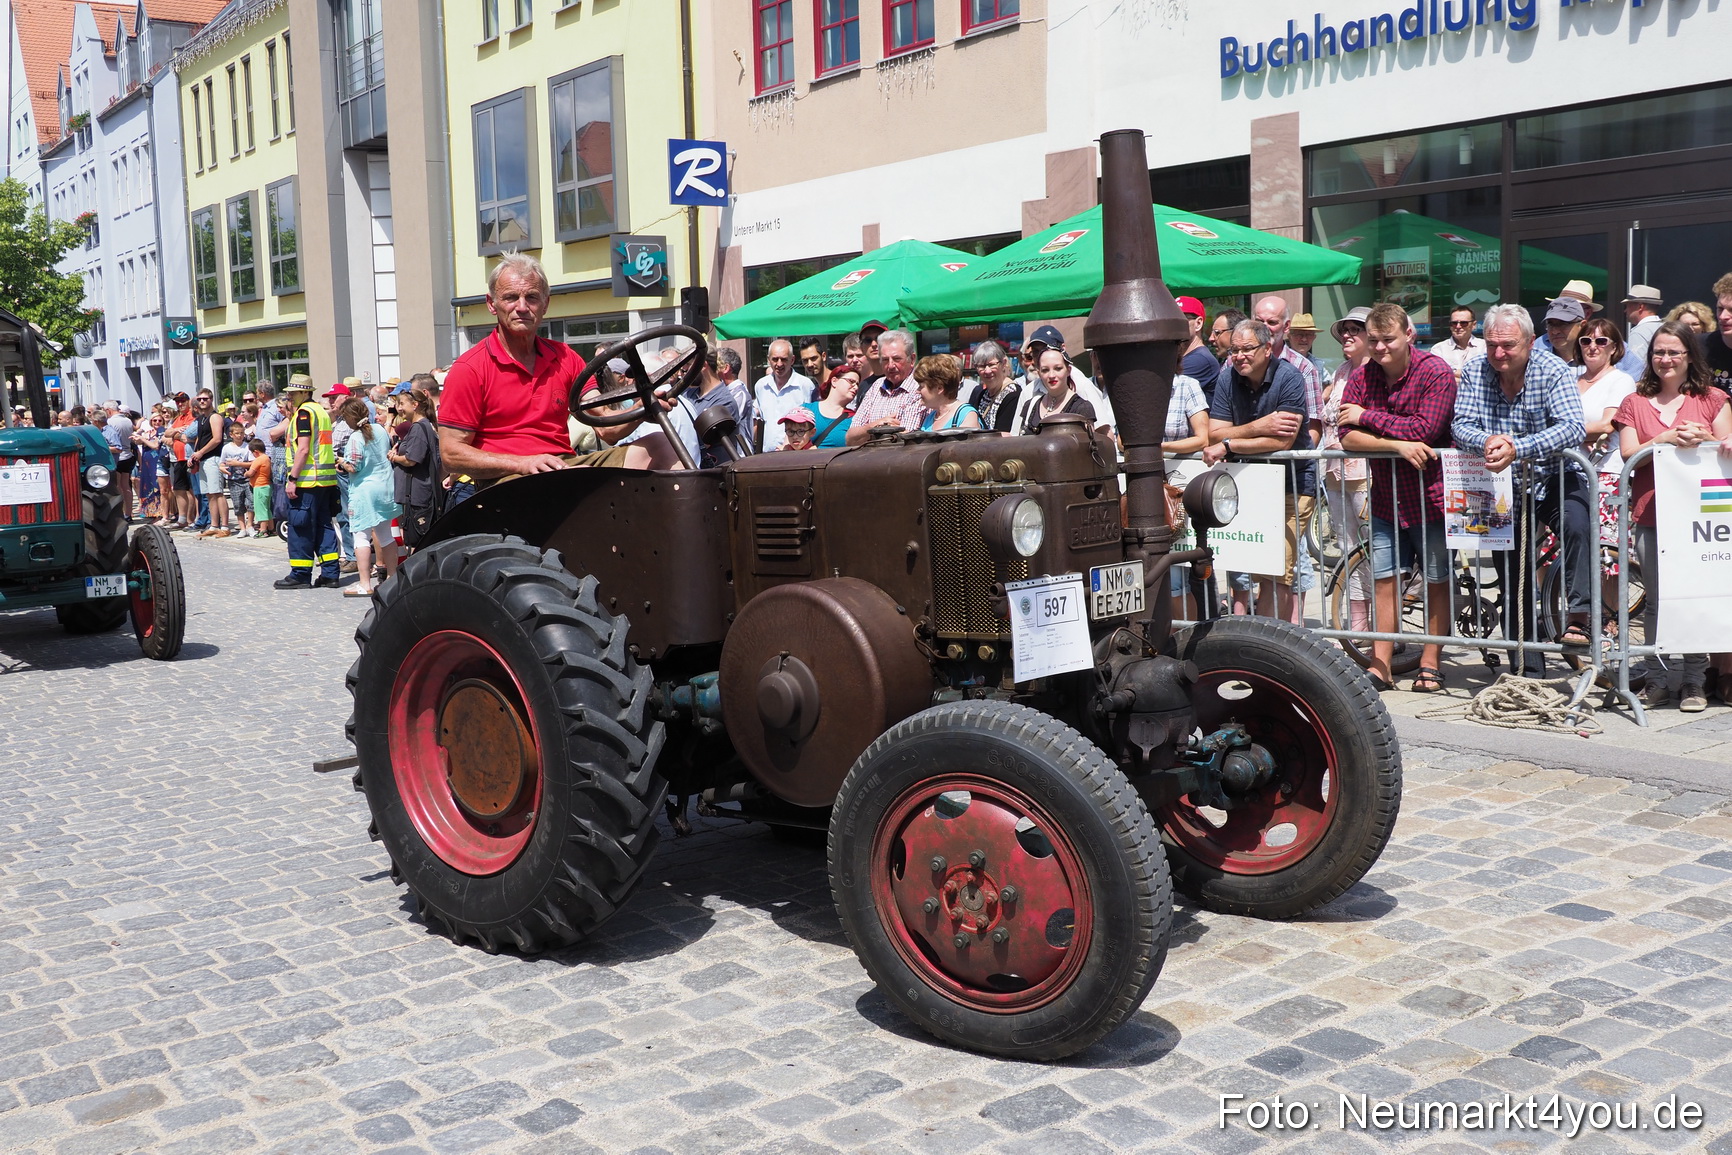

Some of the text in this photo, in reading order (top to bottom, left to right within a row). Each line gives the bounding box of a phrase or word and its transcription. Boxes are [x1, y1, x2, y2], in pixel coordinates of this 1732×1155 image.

[1221, 0, 1538, 79] Buchhandlung
[734, 218, 781, 237] Unterer Markt 15
[635, 251, 655, 277] G2
[1001, 252, 1077, 268] Neumarkter
[1455, 249, 1501, 265] MÄNNER
[973, 259, 1078, 281] Lammsbräu
[1386, 262, 1427, 277] OLDTIMER
[799, 291, 858, 300] Neumarkter
[776, 298, 857, 311] Lammsbräu
[20, 471, 40, 481] 217
[95, 577, 109, 586] NM
[1106, 567, 1123, 592] NM
[94, 586, 119, 596] H 21
[1044, 595, 1067, 618] 597
